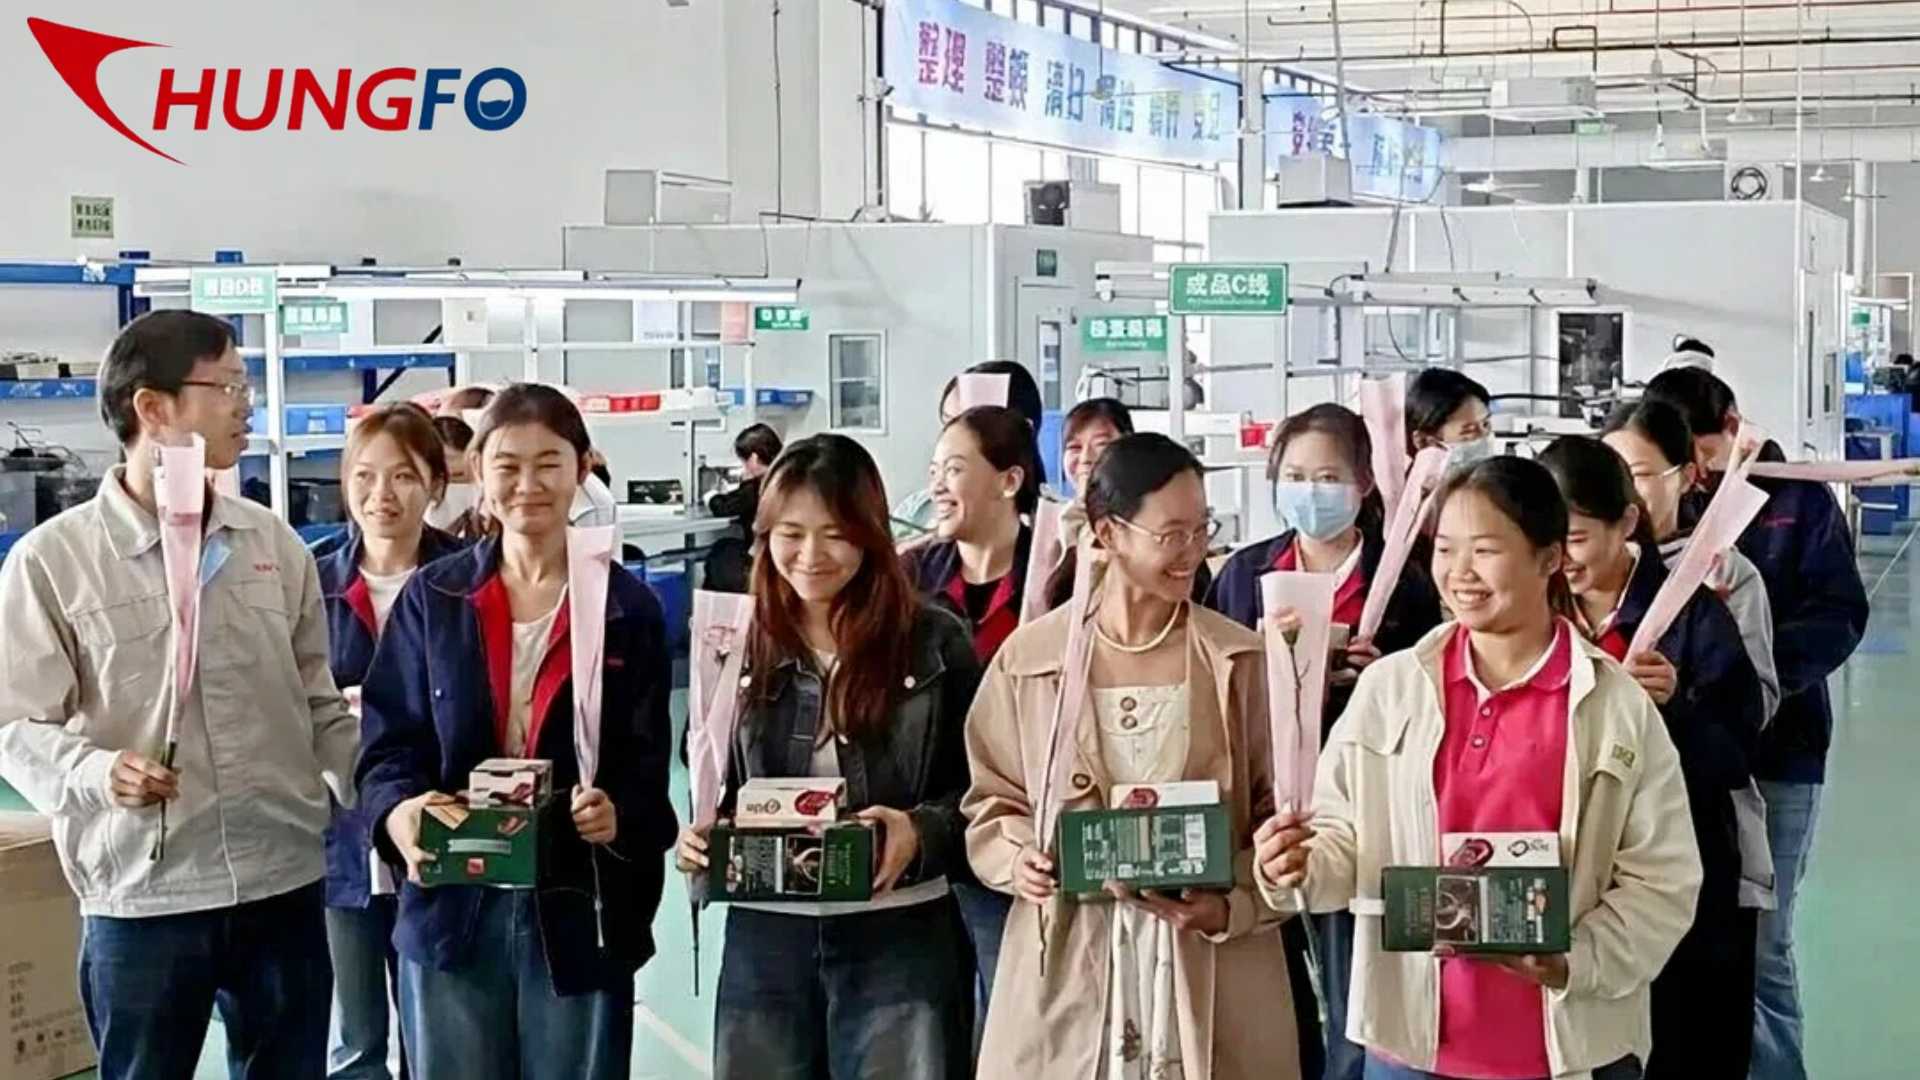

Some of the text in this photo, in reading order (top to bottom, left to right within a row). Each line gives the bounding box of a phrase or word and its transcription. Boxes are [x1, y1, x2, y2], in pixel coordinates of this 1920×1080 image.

[918, 21, 966, 94] 整理
[1045, 59, 1086, 122] 清扫
[1186, 271, 1271, 297] 成品C线
